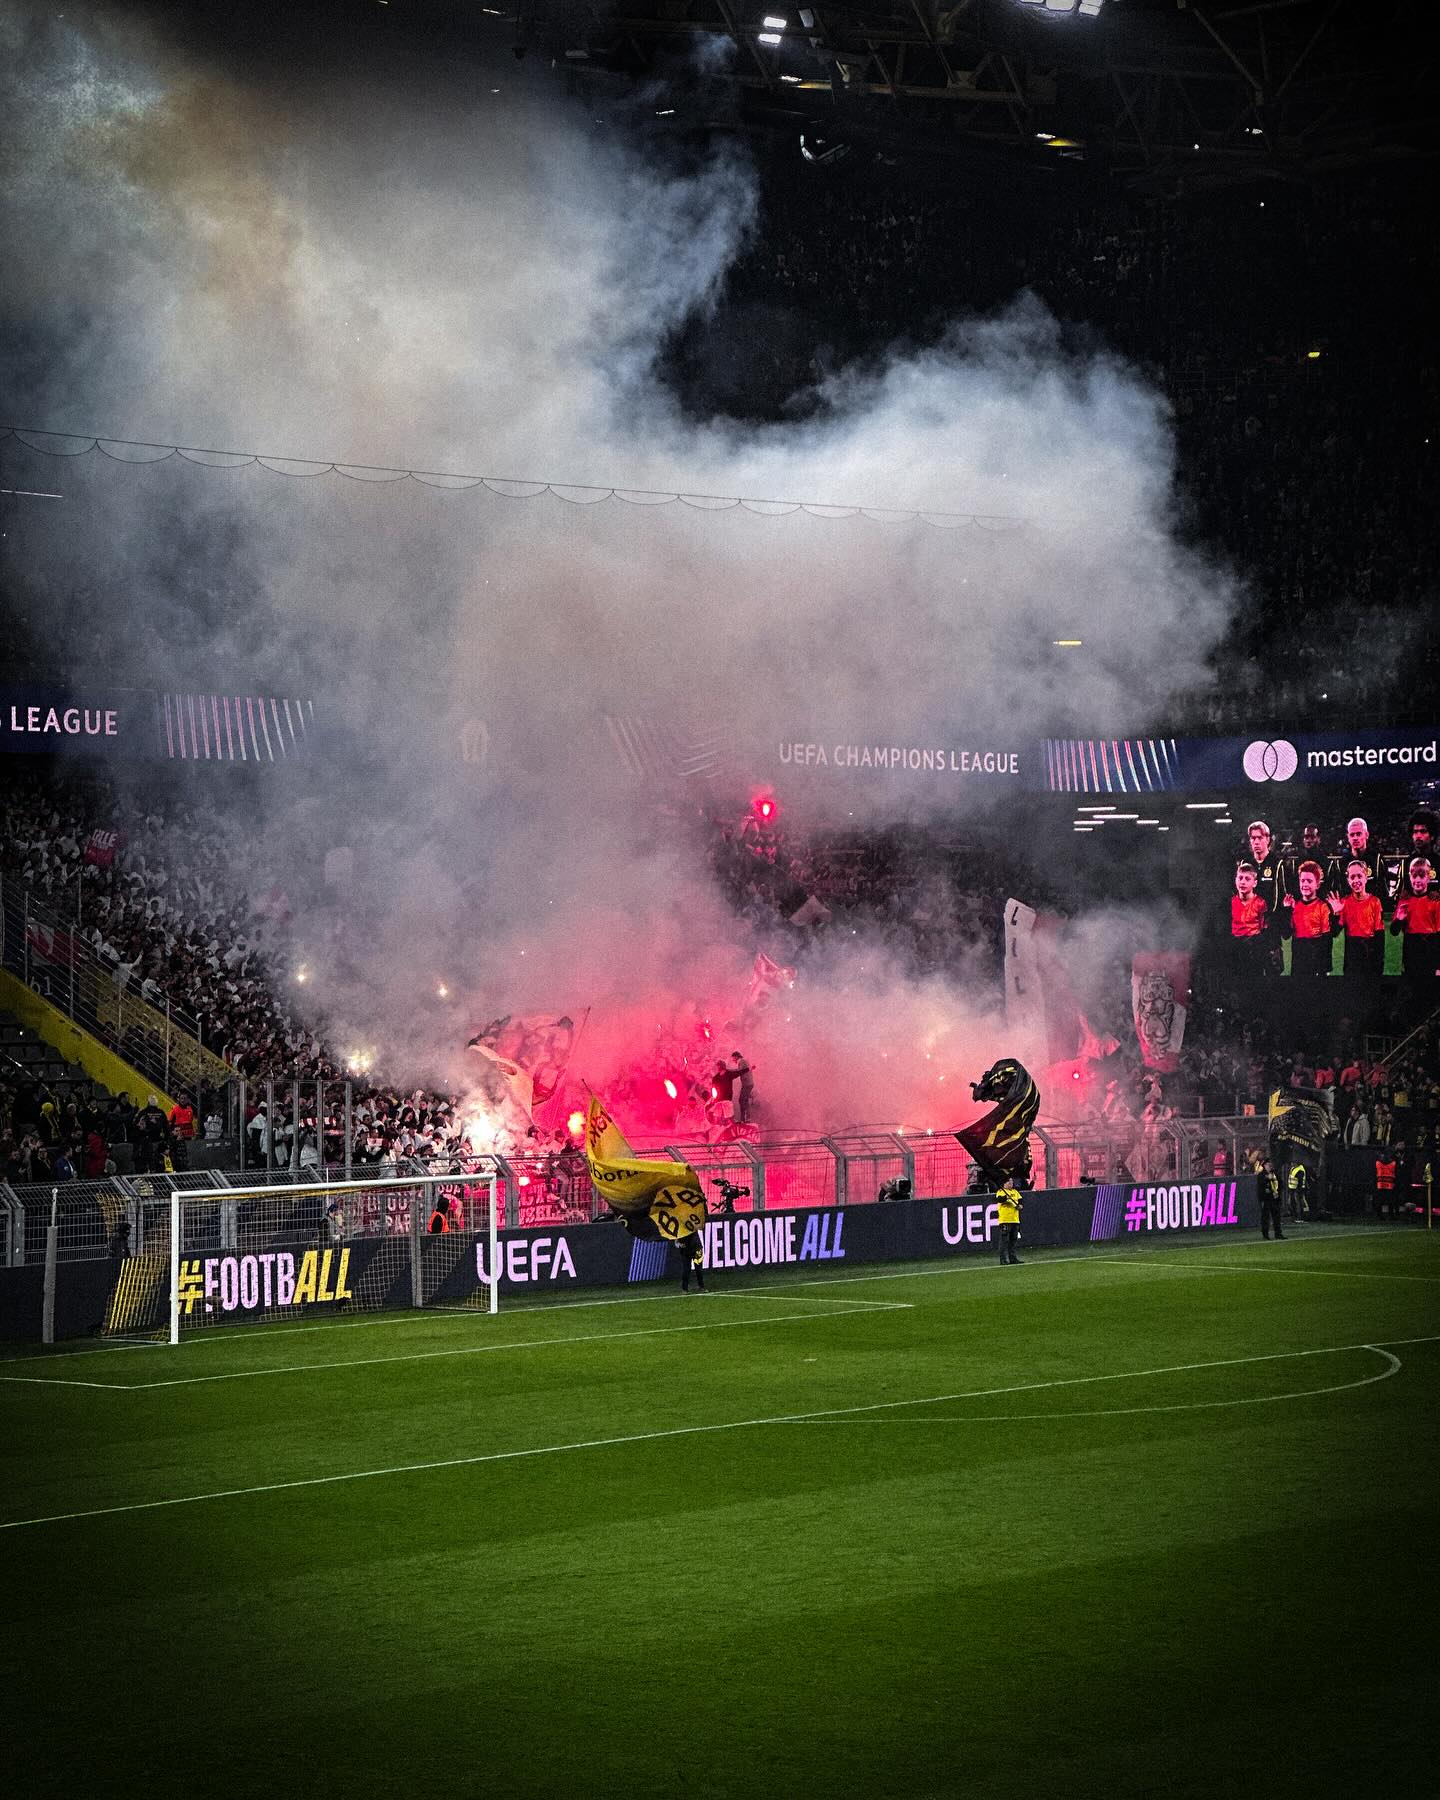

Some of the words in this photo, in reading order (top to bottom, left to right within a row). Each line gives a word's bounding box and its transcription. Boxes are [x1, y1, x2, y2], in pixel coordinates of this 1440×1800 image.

[11, 705, 118, 735] LEAGUE
[779, 743, 829, 766] UEFA
[833, 745, 946, 771] CHAMPIONS
[950, 751, 1019, 774] LEAGUE
[1307, 740, 1437, 768] mastercard
[684, 1213, 702, 1232] 09
[942, 1203, 1000, 1245] UEF
[1124, 1182, 1239, 1232] #FOOTBALL
[799, 1212, 846, 1261] ALL
[177, 1248, 352, 1315] #FOOTBALL
[476, 1237, 577, 1284] UEFA
